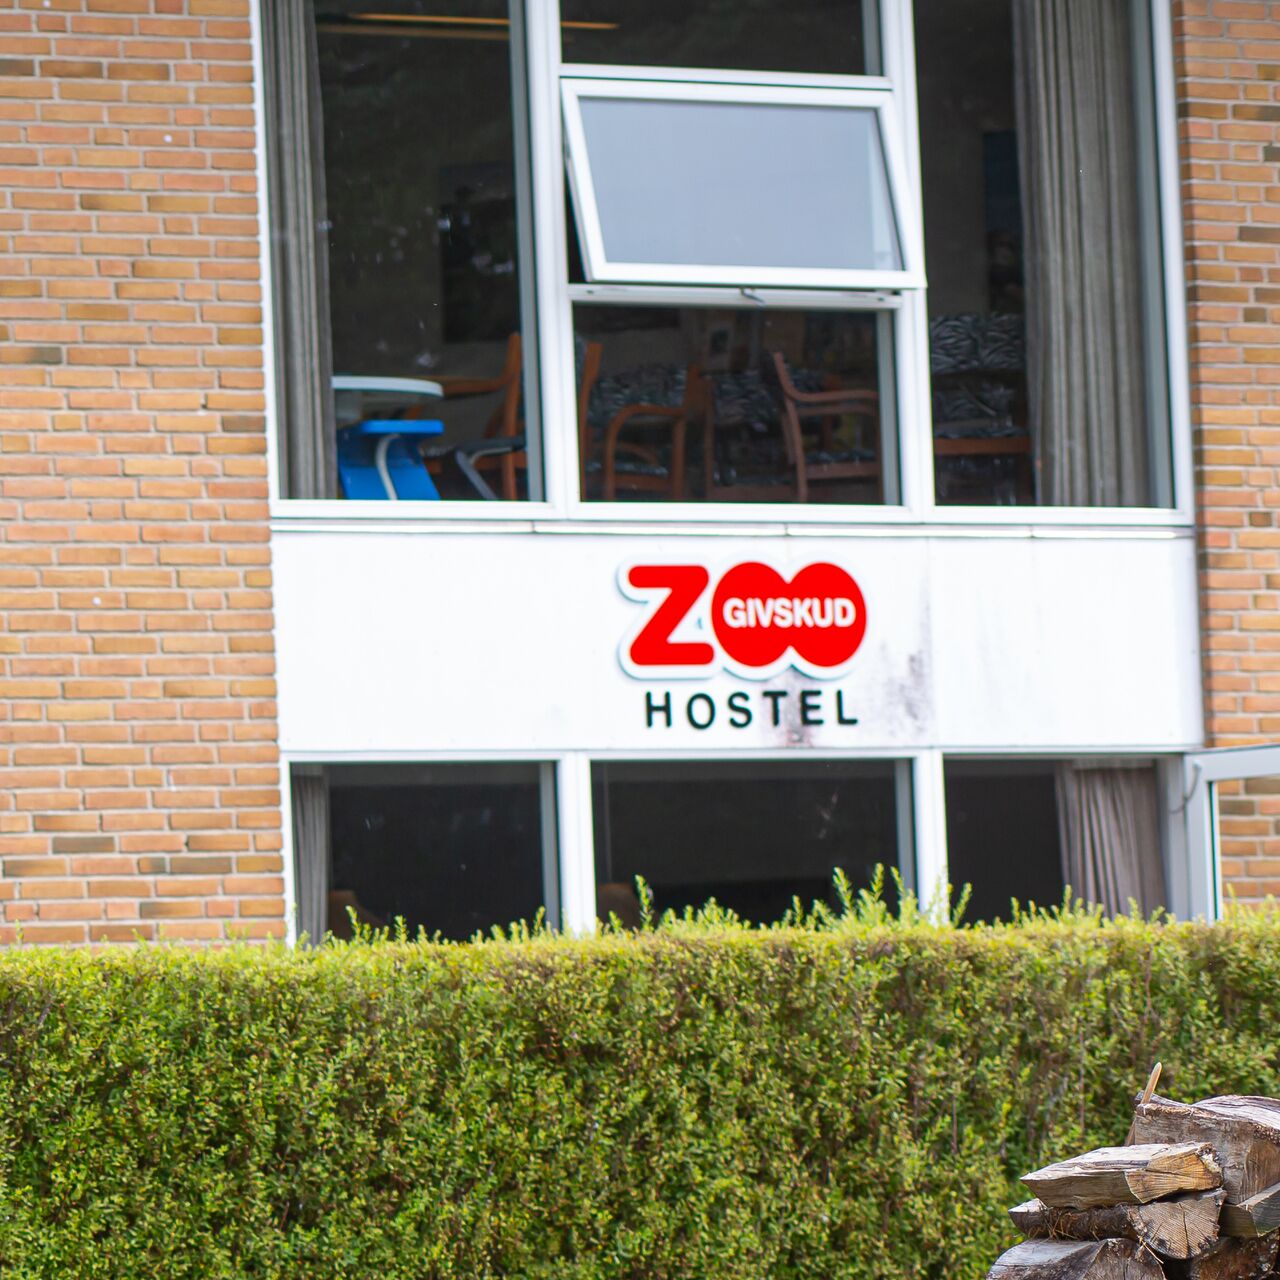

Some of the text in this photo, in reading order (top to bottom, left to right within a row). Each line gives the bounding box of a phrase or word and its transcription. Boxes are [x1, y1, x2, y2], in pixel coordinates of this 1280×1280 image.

[628, 562, 868, 668] ZOO
[723, 597, 857, 629] GIVSKUD
[645, 690, 859, 730] HOSTEL
